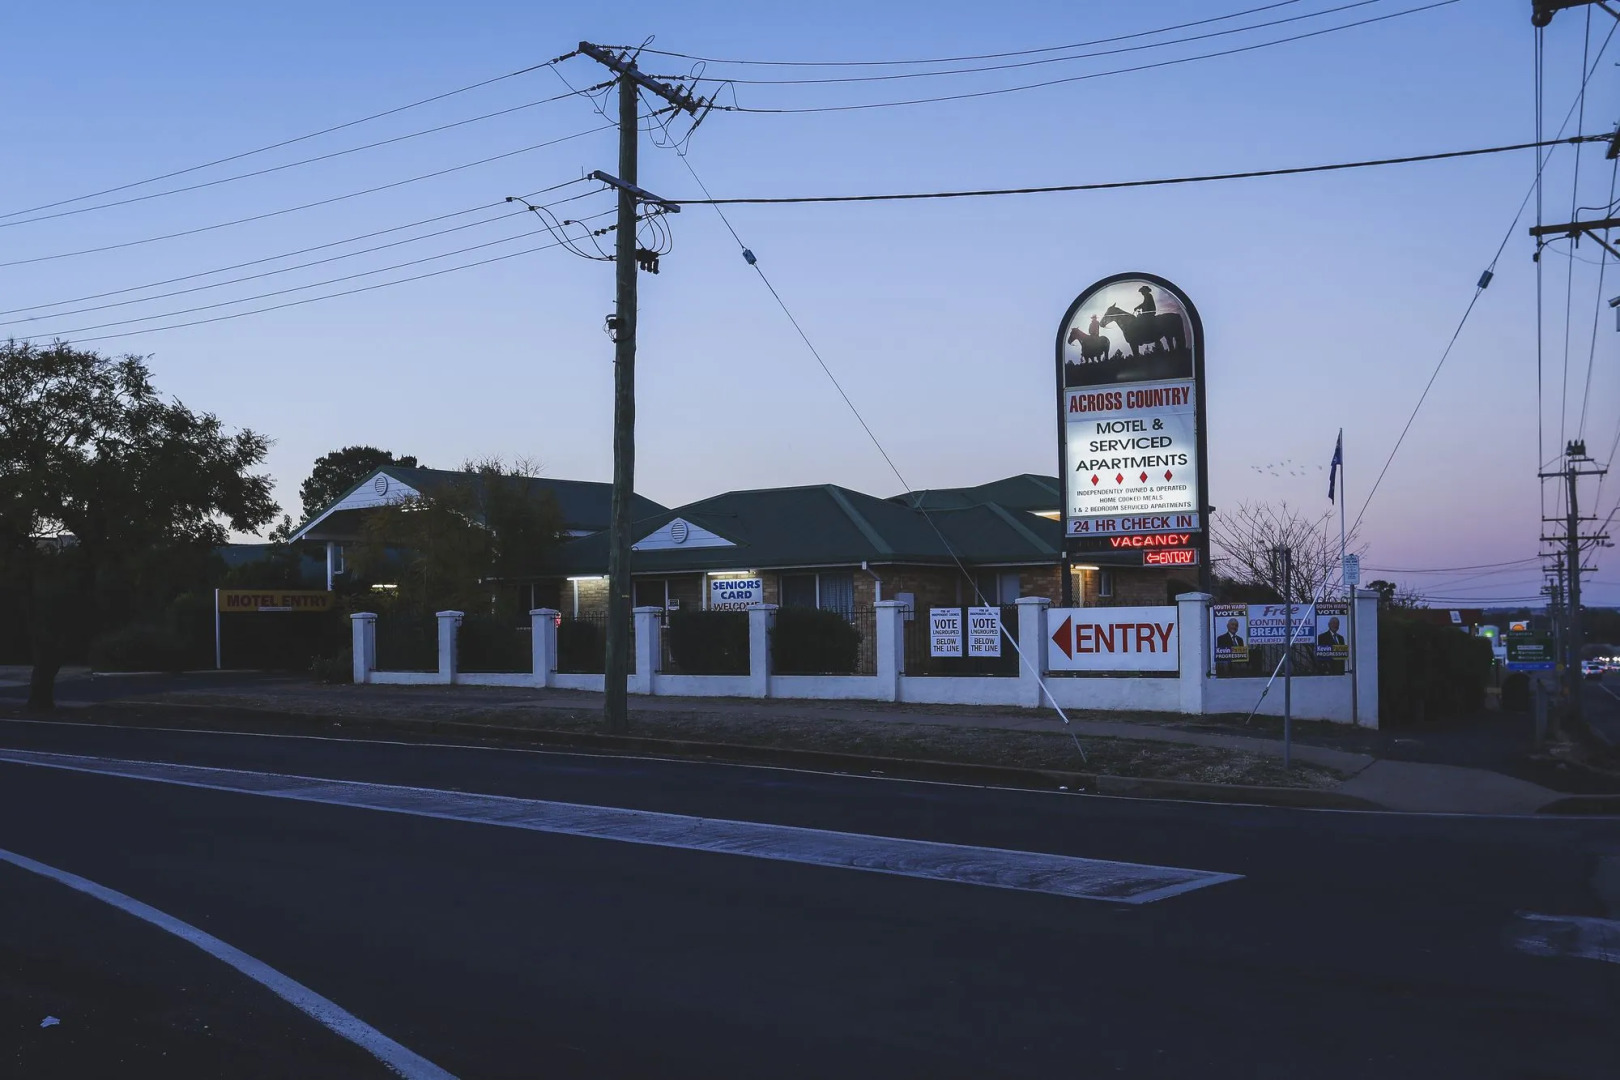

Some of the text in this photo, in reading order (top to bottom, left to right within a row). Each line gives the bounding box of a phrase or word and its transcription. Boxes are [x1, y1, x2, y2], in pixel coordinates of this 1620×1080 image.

[1069, 386, 1190, 413] ACROSS COUNTRY
[1096, 418, 1164, 434] MOTEL &
[1090, 436, 1172, 452] SERVICED
[1076, 454, 1188, 472] APARTMENTS
[1076, 488, 1124, 496] INDEPENDENTLY
[1073, 515, 1192, 532] 24 HR CHECK IN
[1110, 534, 1190, 548] VACANCY
[1160, 551, 1192, 564] ENTRY
[713, 580, 760, 590] SENIORS
[227, 594, 328, 607] MOTEL ENTRY
[720, 591, 752, 600] CARD
[1263, 606, 1299, 616] Free
[934, 619, 957, 629] VOTE
[972, 618, 996, 628] VOTE
[1250, 618, 1313, 626] CONTINNTAL
[1076, 622, 1174, 653] ENTRY
[1250, 627, 1310, 636] BREAKAST
